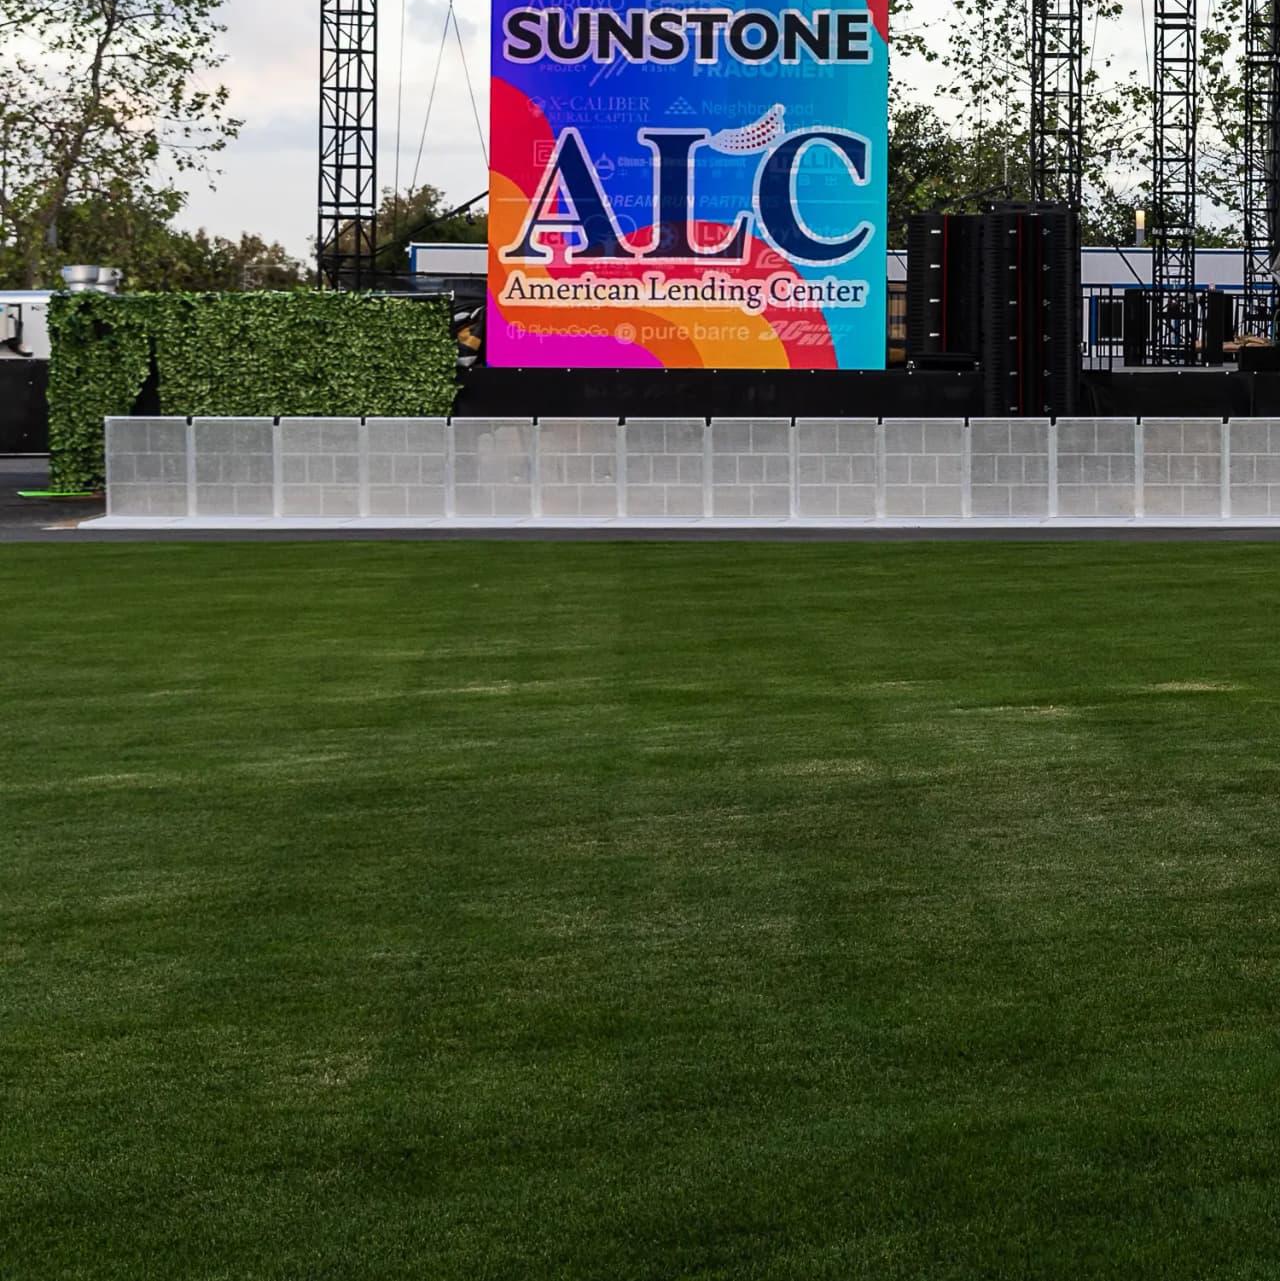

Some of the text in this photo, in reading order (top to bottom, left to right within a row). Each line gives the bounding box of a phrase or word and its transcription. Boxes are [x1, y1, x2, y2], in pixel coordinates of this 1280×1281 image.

[507, 12, 869, 60] SUNSTONE
[692, 61, 835, 77] FRAGOMEN
[505, 130, 869, 262] ALC
[505, 276, 864, 309] American Lending Center
[528, 324, 609, 343] AlphaGoGo
[641, 322, 750, 343] pure barre
